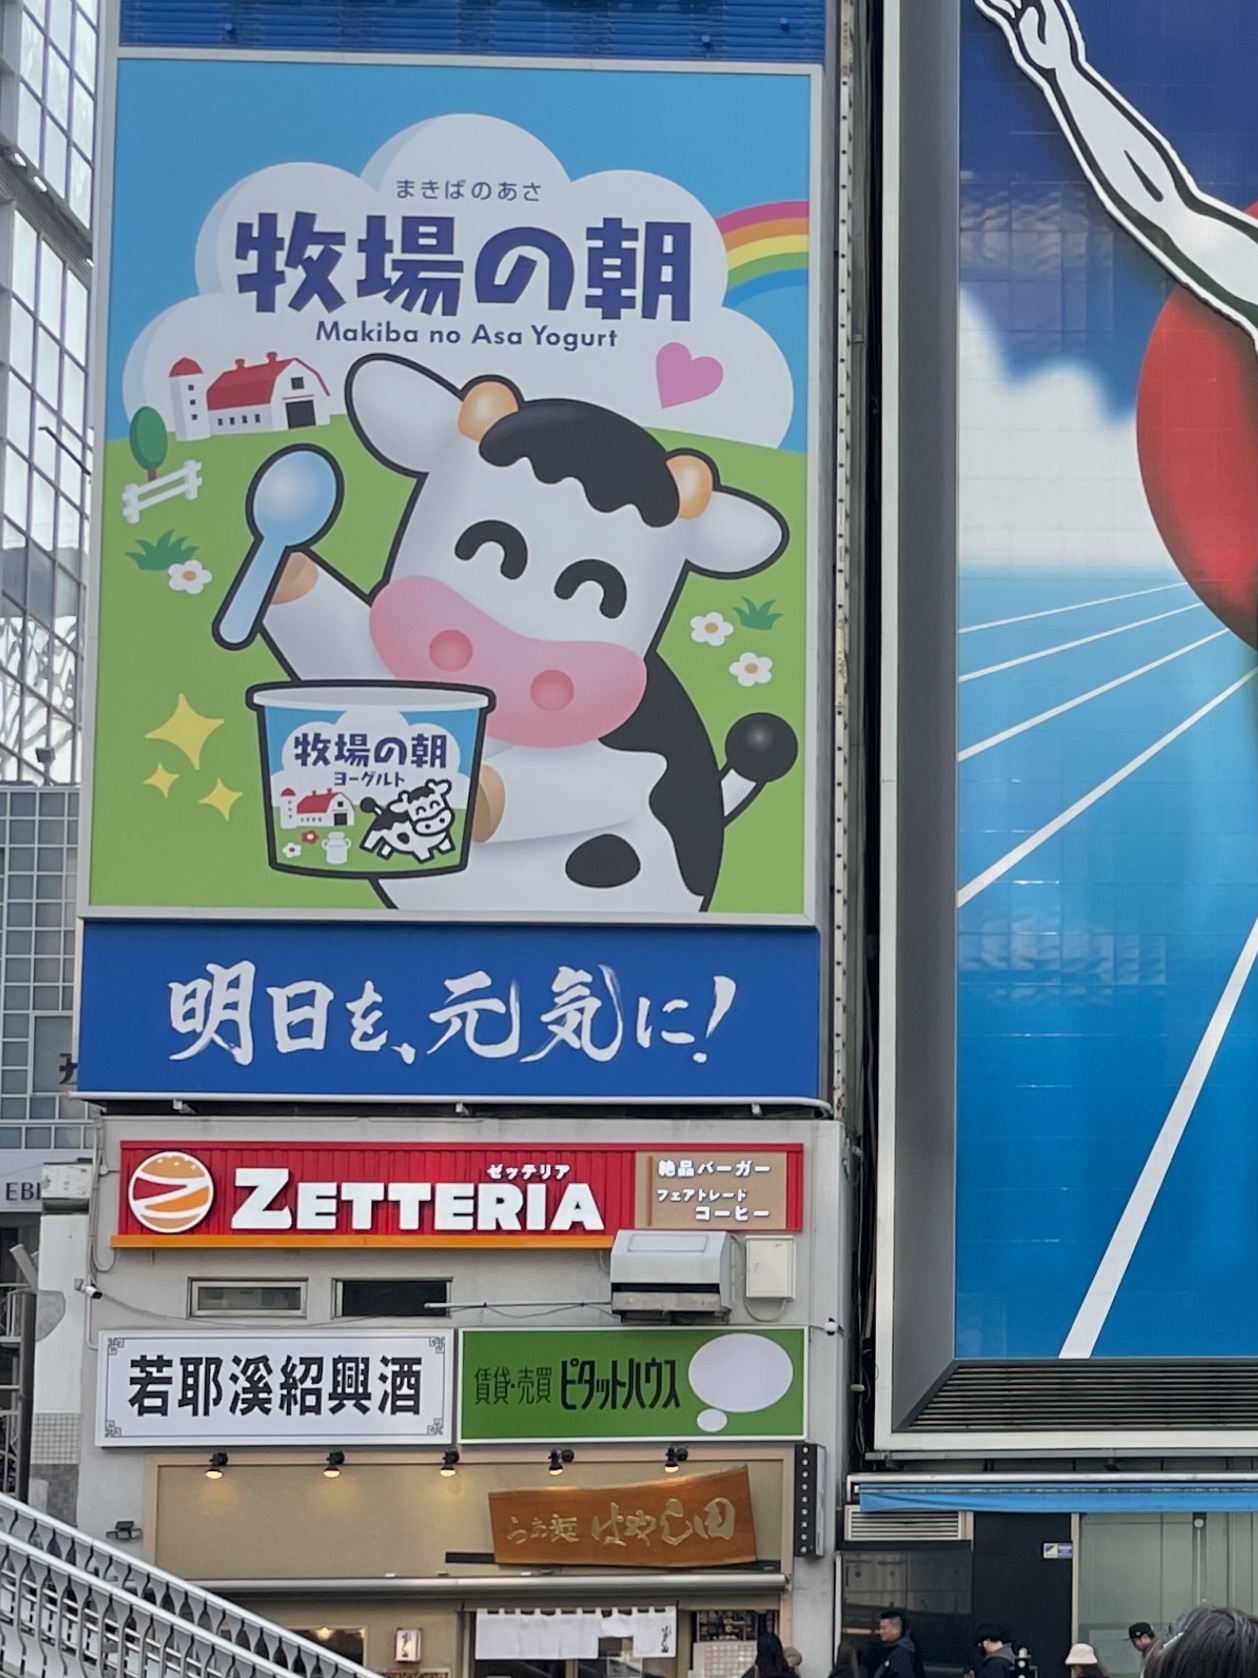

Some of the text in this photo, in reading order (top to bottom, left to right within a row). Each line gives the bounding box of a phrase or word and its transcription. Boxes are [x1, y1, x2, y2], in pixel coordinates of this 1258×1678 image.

[395, 178, 543, 203] まきばのあさ
[234, 210, 693, 322] 牧場の朝
[314, 320, 618, 353] Makiba no Asa Yogurt
[292, 733, 448, 770] 牧場の朝
[333, 770, 405, 789] ヨーグルト
[167, 960, 738, 1066] 明日を、元気に!
[487, 1163, 571, 1180] ゼッテリア
[658, 1160, 770, 1177] 絶品バーガー
[231, 1167, 606, 1231] ZETTERIA
[657, 1189, 747, 1202] フェアトレード
[695, 1205, 770, 1221] コーヒー
[128, 1354, 422, 1417] 若耶溪紹興酒
[474, 1357, 681, 1410] 賃貸・売買 ピタットハウス
